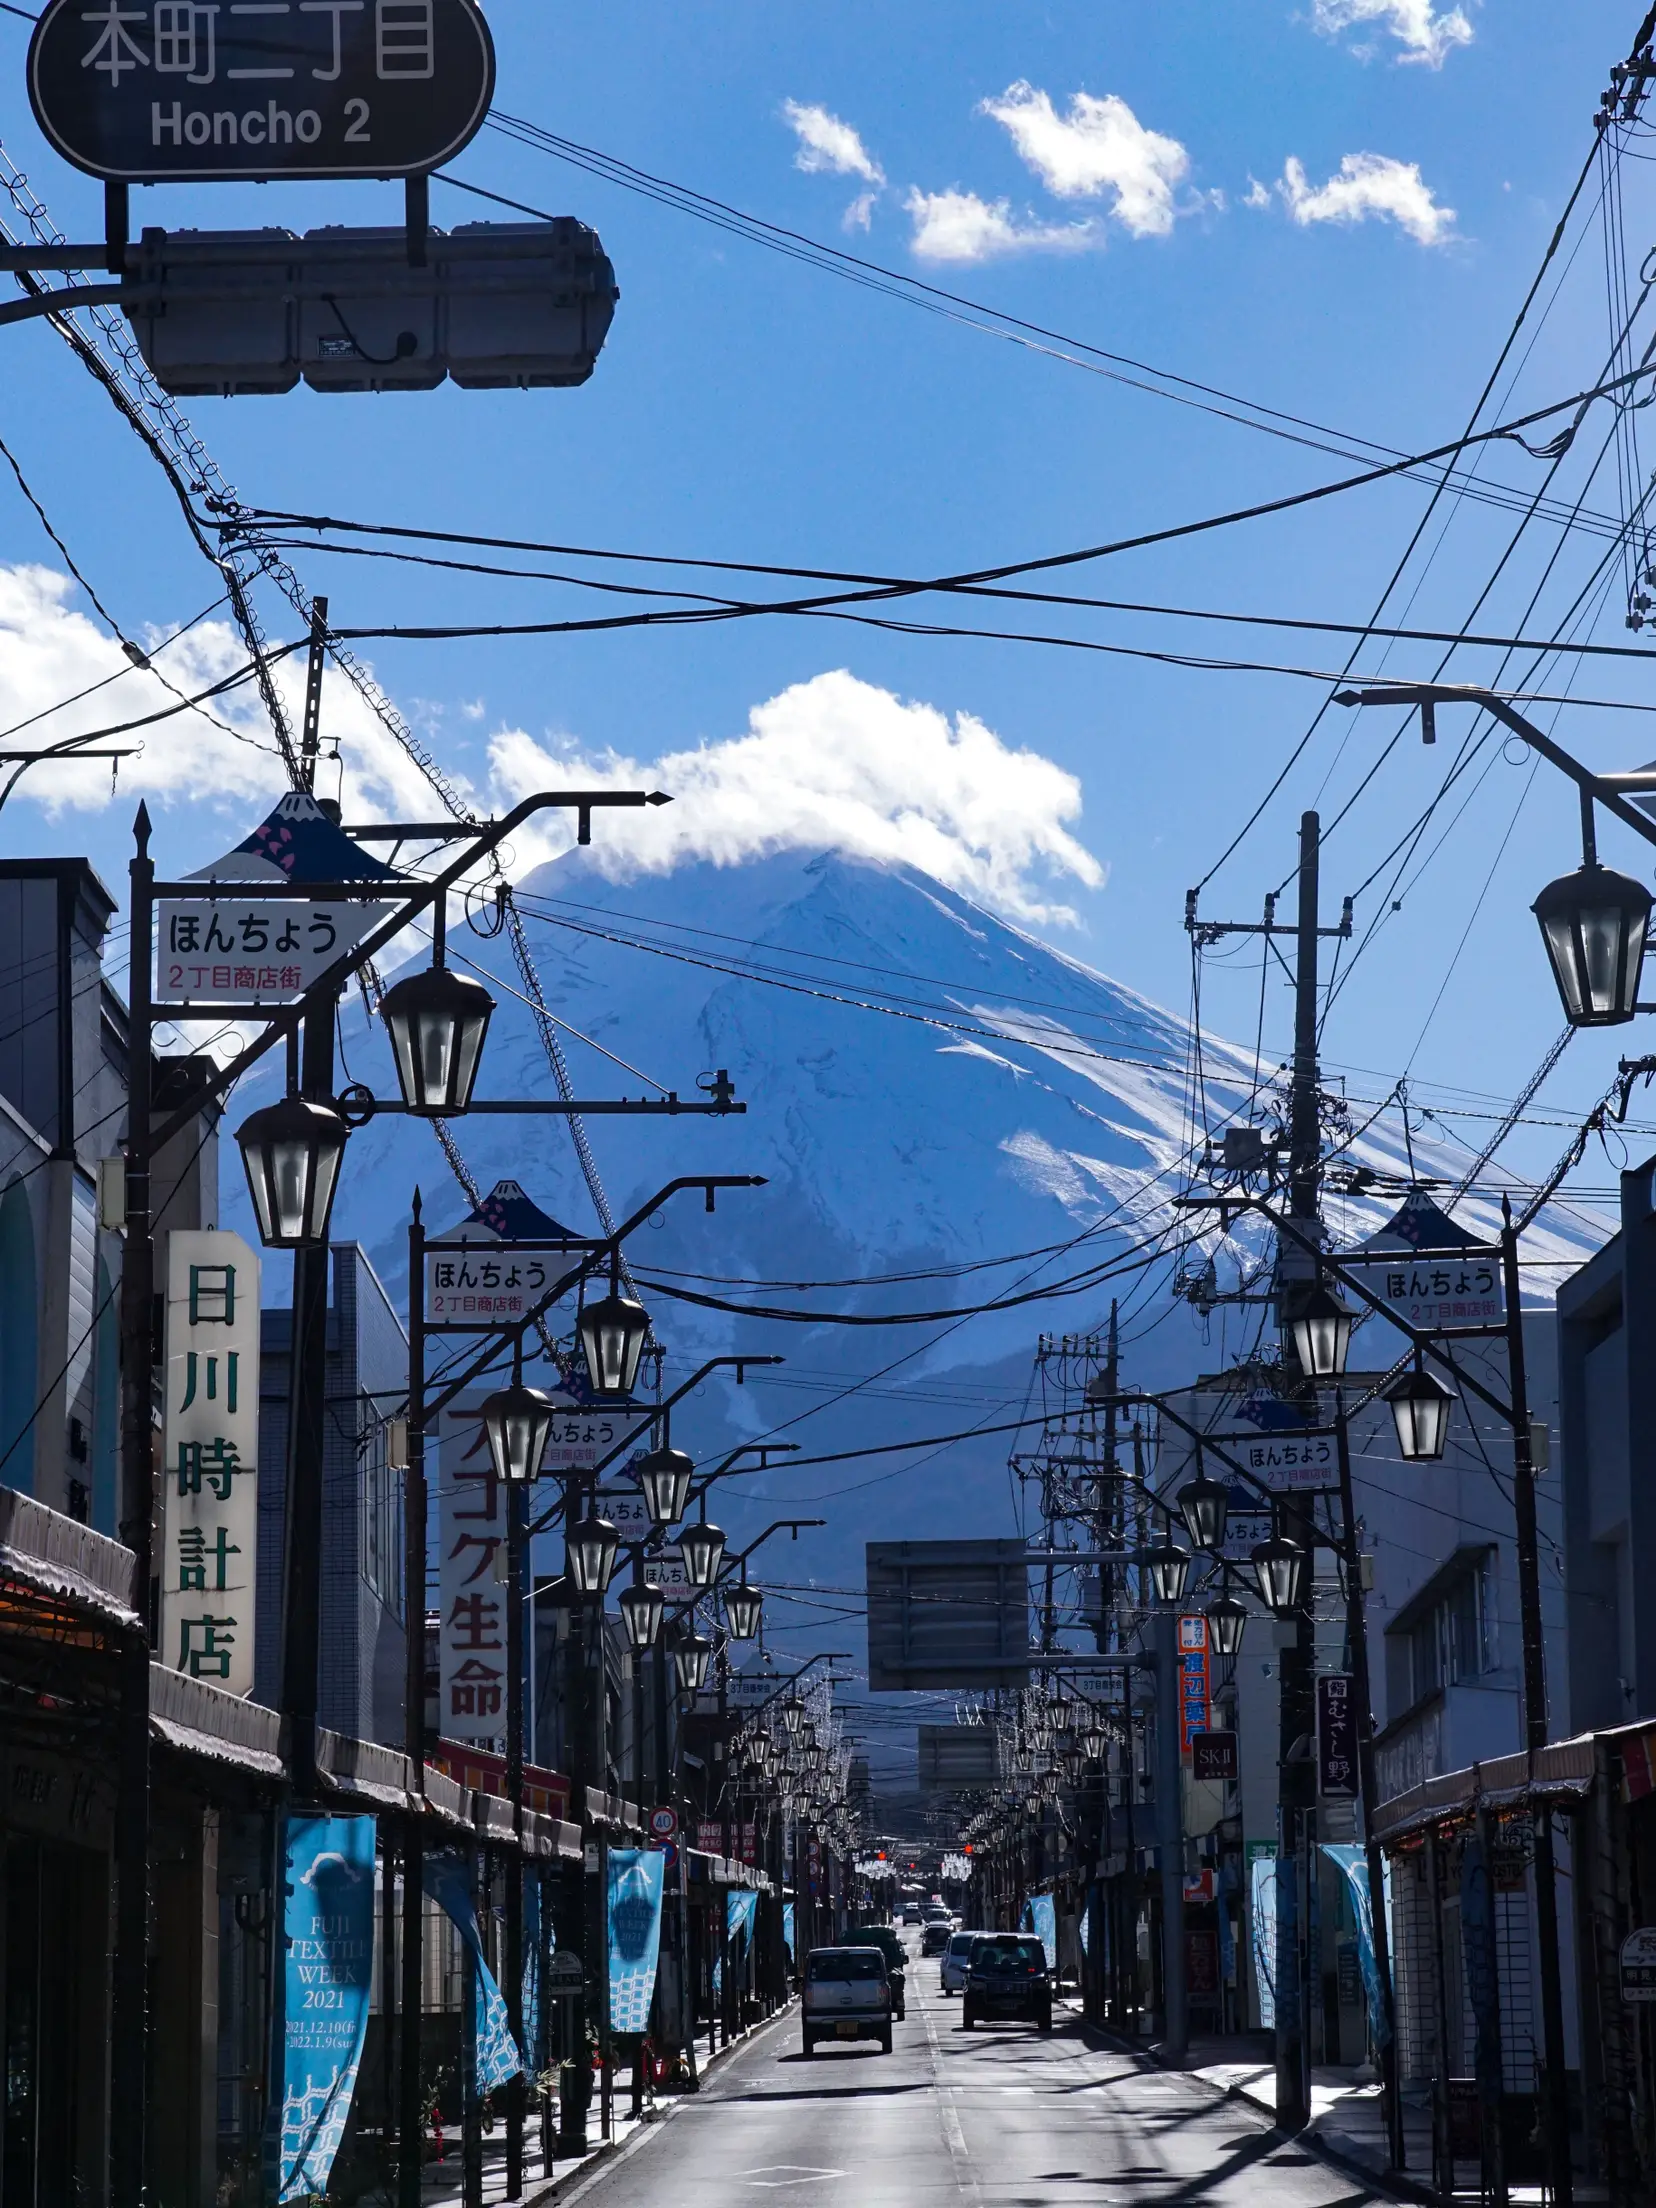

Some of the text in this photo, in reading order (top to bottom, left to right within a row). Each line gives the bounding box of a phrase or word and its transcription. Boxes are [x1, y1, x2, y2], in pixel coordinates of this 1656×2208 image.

[81, 0, 434, 87] 本町二丁目
[152, 99, 371, 146] Honcho 2
[170, 913, 336, 953] ほんちょう
[168, 965, 302, 990] 2丁目商店街
[435, 1261, 545, 1289] ほんちょう
[1387, 1268, 1494, 1298] ほんちょう
[434, 1296, 522, 1312] 2丁目商店街
[1410, 1301, 1496, 1320] 2丁目商店街
[549, 1422, 613, 1443] んちょう
[1250, 1442, 1330, 1468] ほんちょう
[178, 1264, 241, 1680] 日川時計店
[1328, 1700, 1350, 1781] むさし野
[656, 1815, 671, 1828] 40
[309, 1915, 350, 1939] FUJI
[297, 1966, 357, 1985] WEEK
[302, 1990, 345, 2009] 2021
